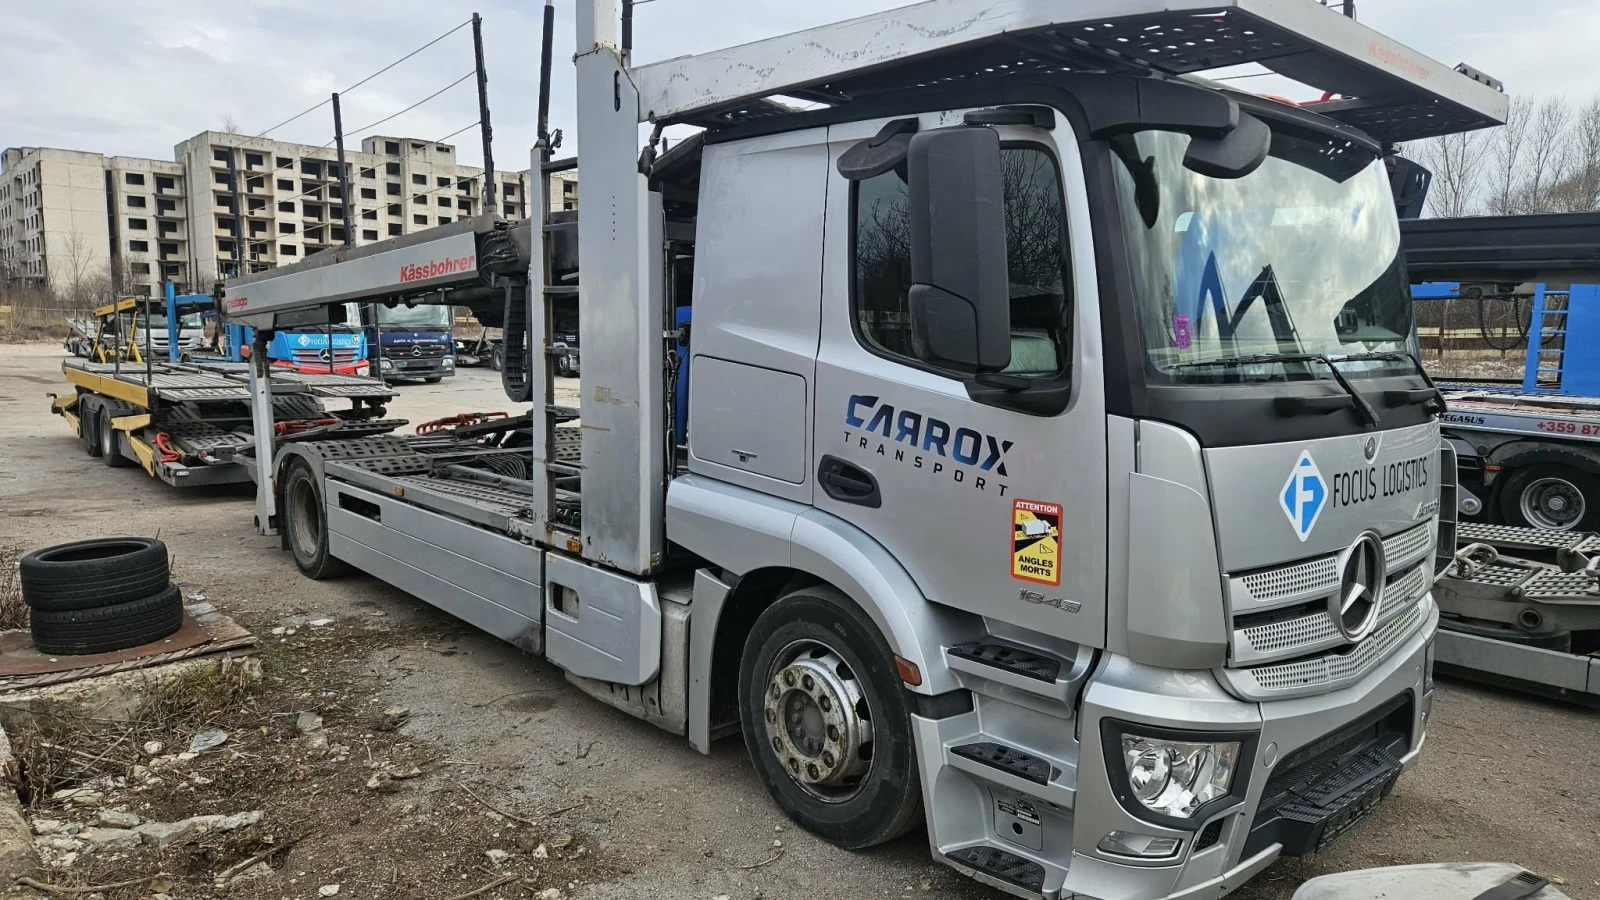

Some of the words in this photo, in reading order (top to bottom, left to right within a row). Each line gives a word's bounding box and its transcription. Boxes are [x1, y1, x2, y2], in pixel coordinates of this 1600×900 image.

[400, 256, 475, 282] Kässbohrer
[845, 394, 1014, 477] CARROX
[1537, 421, 1576, 434] +359
[844, 431, 1008, 497] TRANSPORT
[1333, 467, 1377, 508] FOCUS
[1383, 456, 1428, 497] LOGISTICS
[1015, 501, 1058, 514] ATTENTION
[1018, 555, 1054, 568] ANGLES
[1020, 564, 1051, 577] MORTS
